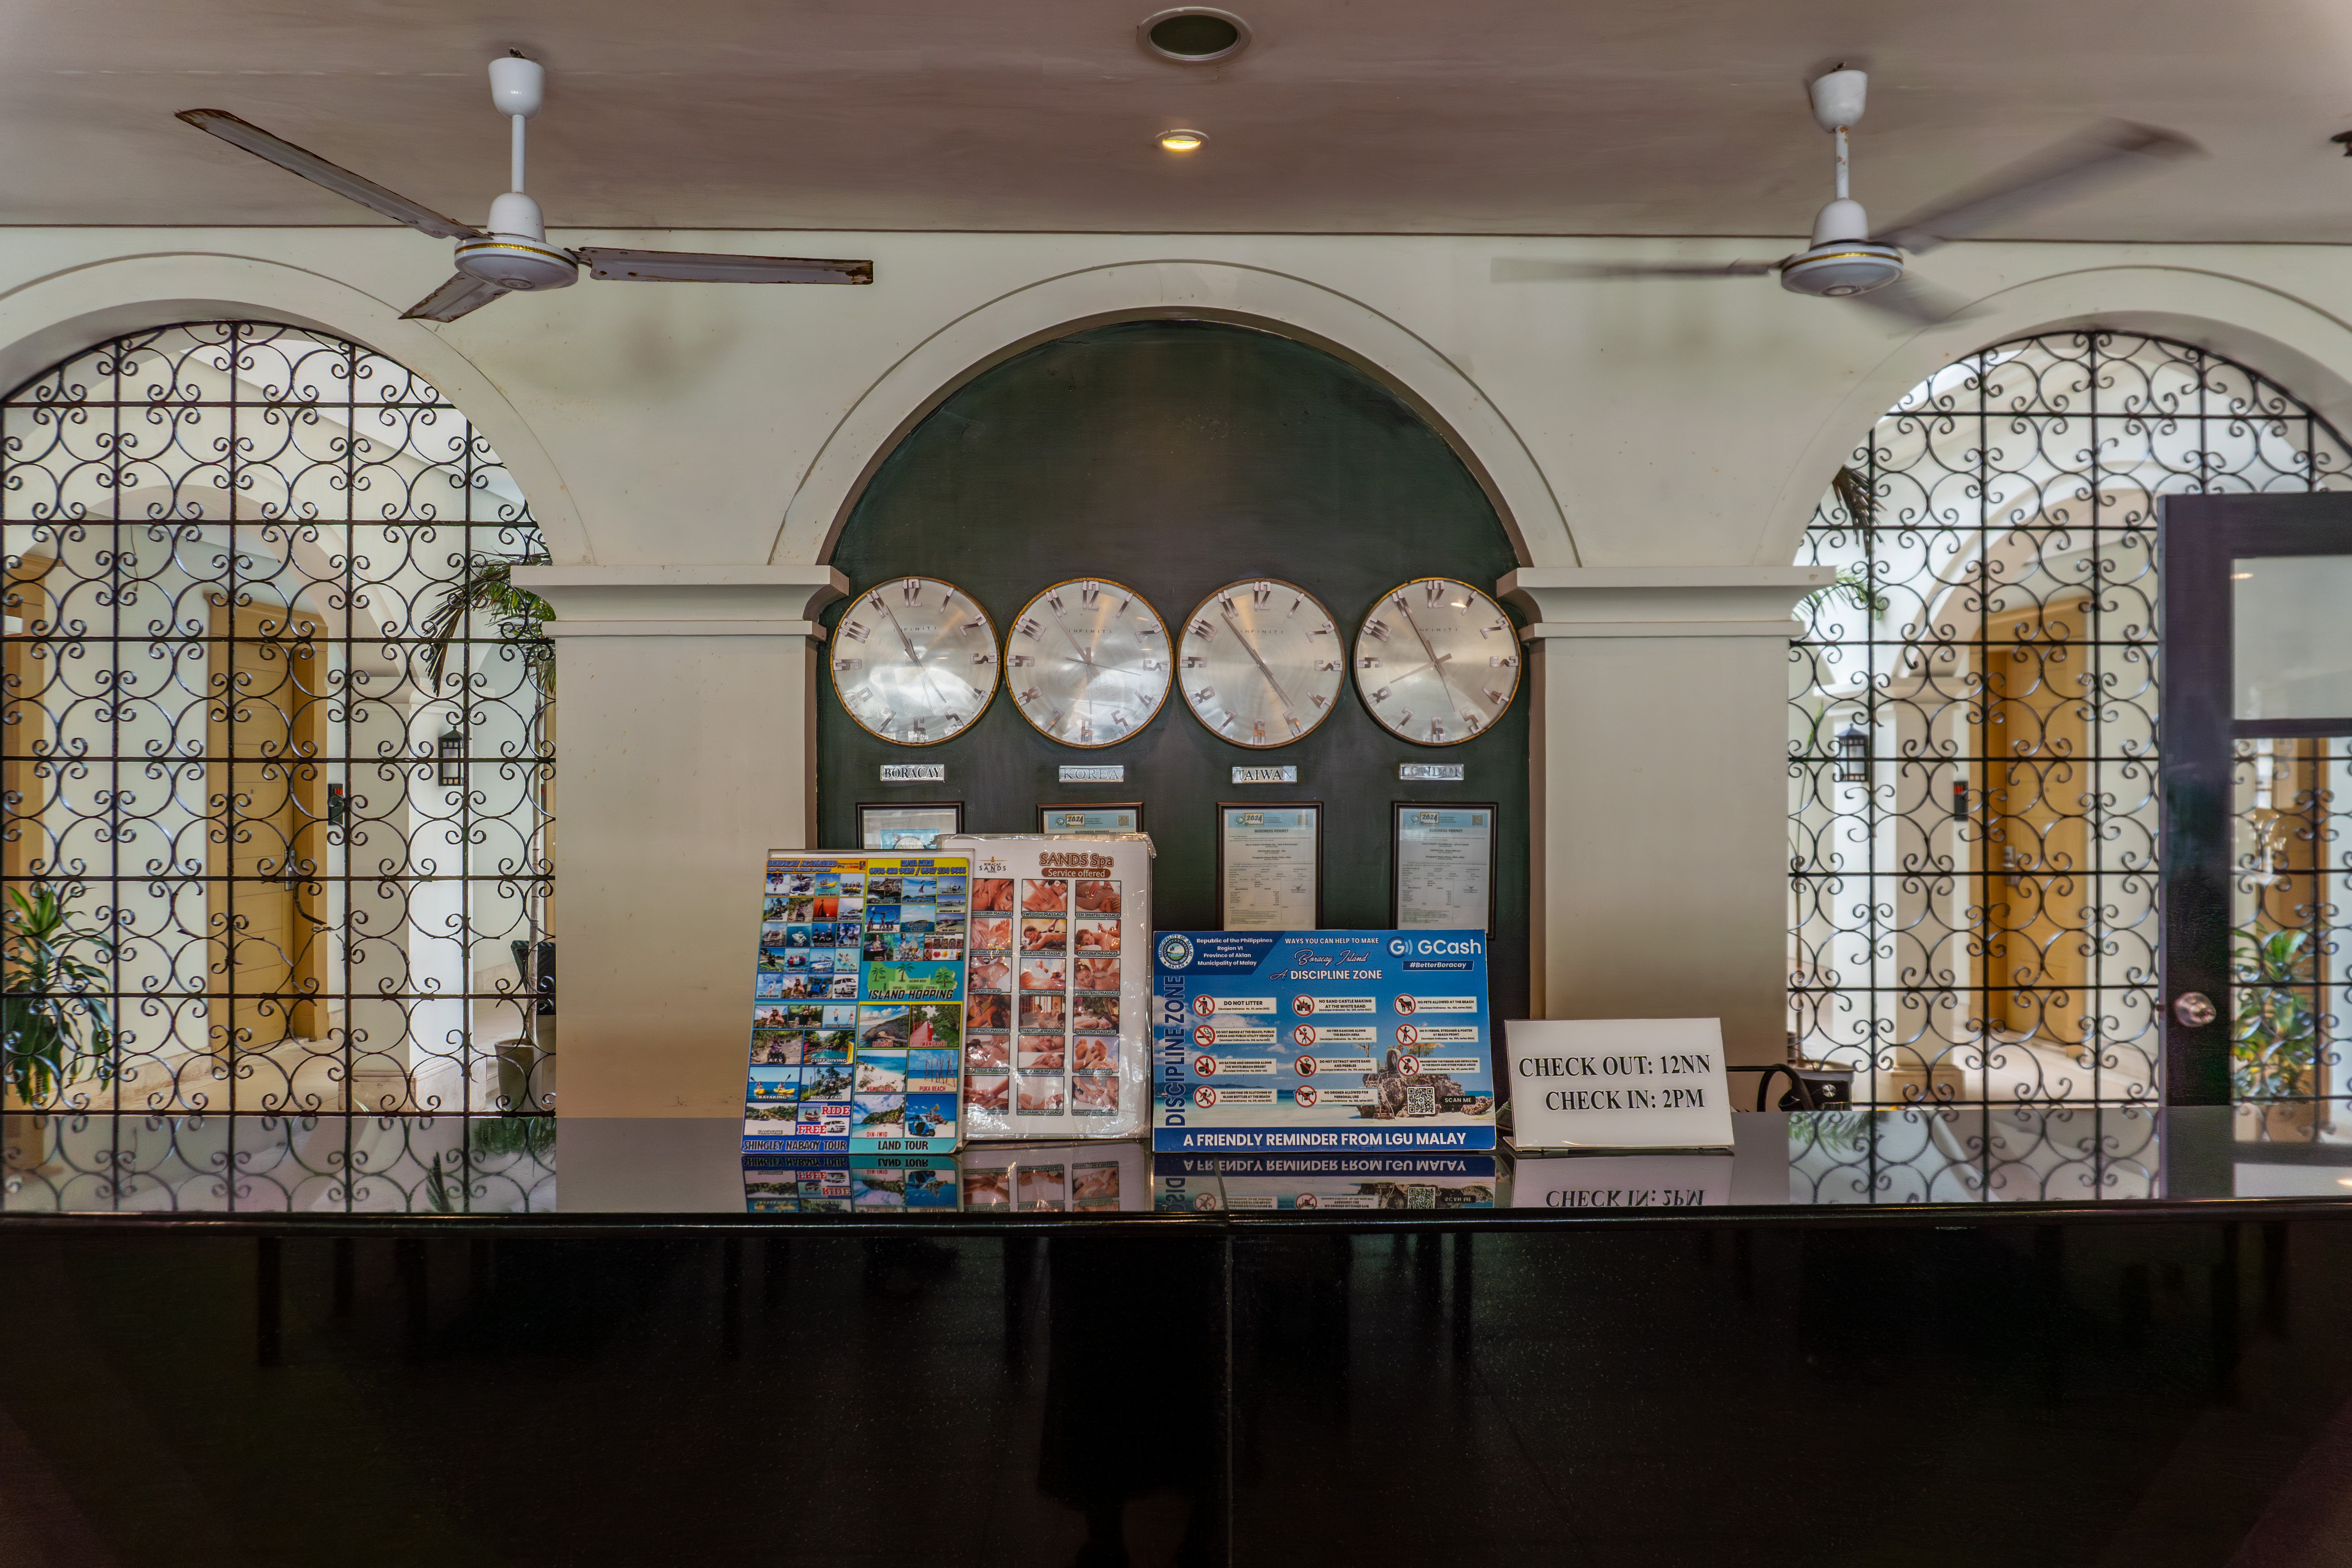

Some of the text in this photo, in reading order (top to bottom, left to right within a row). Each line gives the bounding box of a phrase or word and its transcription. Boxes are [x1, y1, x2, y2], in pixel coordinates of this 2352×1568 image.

[902, 579, 922, 608] 12
[1082, 581, 1100, 610] 12
[1253, 581, 1271, 610] 12
[1427, 579, 1445, 608] 12
[884, 766, 942, 779] BORACAY
[1063, 768, 1120, 780] KOREA
[1236, 769, 1294, 781] TAIWAN
[1421, 813, 1437, 822] 2024
[1040, 852, 1114, 869] SANDS Spa
[1159, 935, 1178, 957] MUNICIPALITY
[1418, 939, 1481, 954] GCash
[1294, 949, 1370, 966] Boracay Island
[1290, 970, 1350, 980] DISCIPLINE
[1353, 970, 1383, 979] ZONE
[868, 990, 954, 999] ISLAND HOPPING
[1164, 976, 1185, 1126] DISCIPLINE ZONE
[1519, 1054, 1710, 1077] CHECK OUT: 12NN
[1546, 1089, 1705, 1111] CHECK IN: 2PM
[821, 1106, 850, 1115] RIDE
[797, 1125, 827, 1134] FREE
[743, 1140, 847, 1151] SHINGLEY NABAOY TOUR
[878, 1141, 929, 1150] LAND TOUR
[1183, 1132, 1466, 1146] A FRIENDLY REMINDER FROM LGU MALAY
